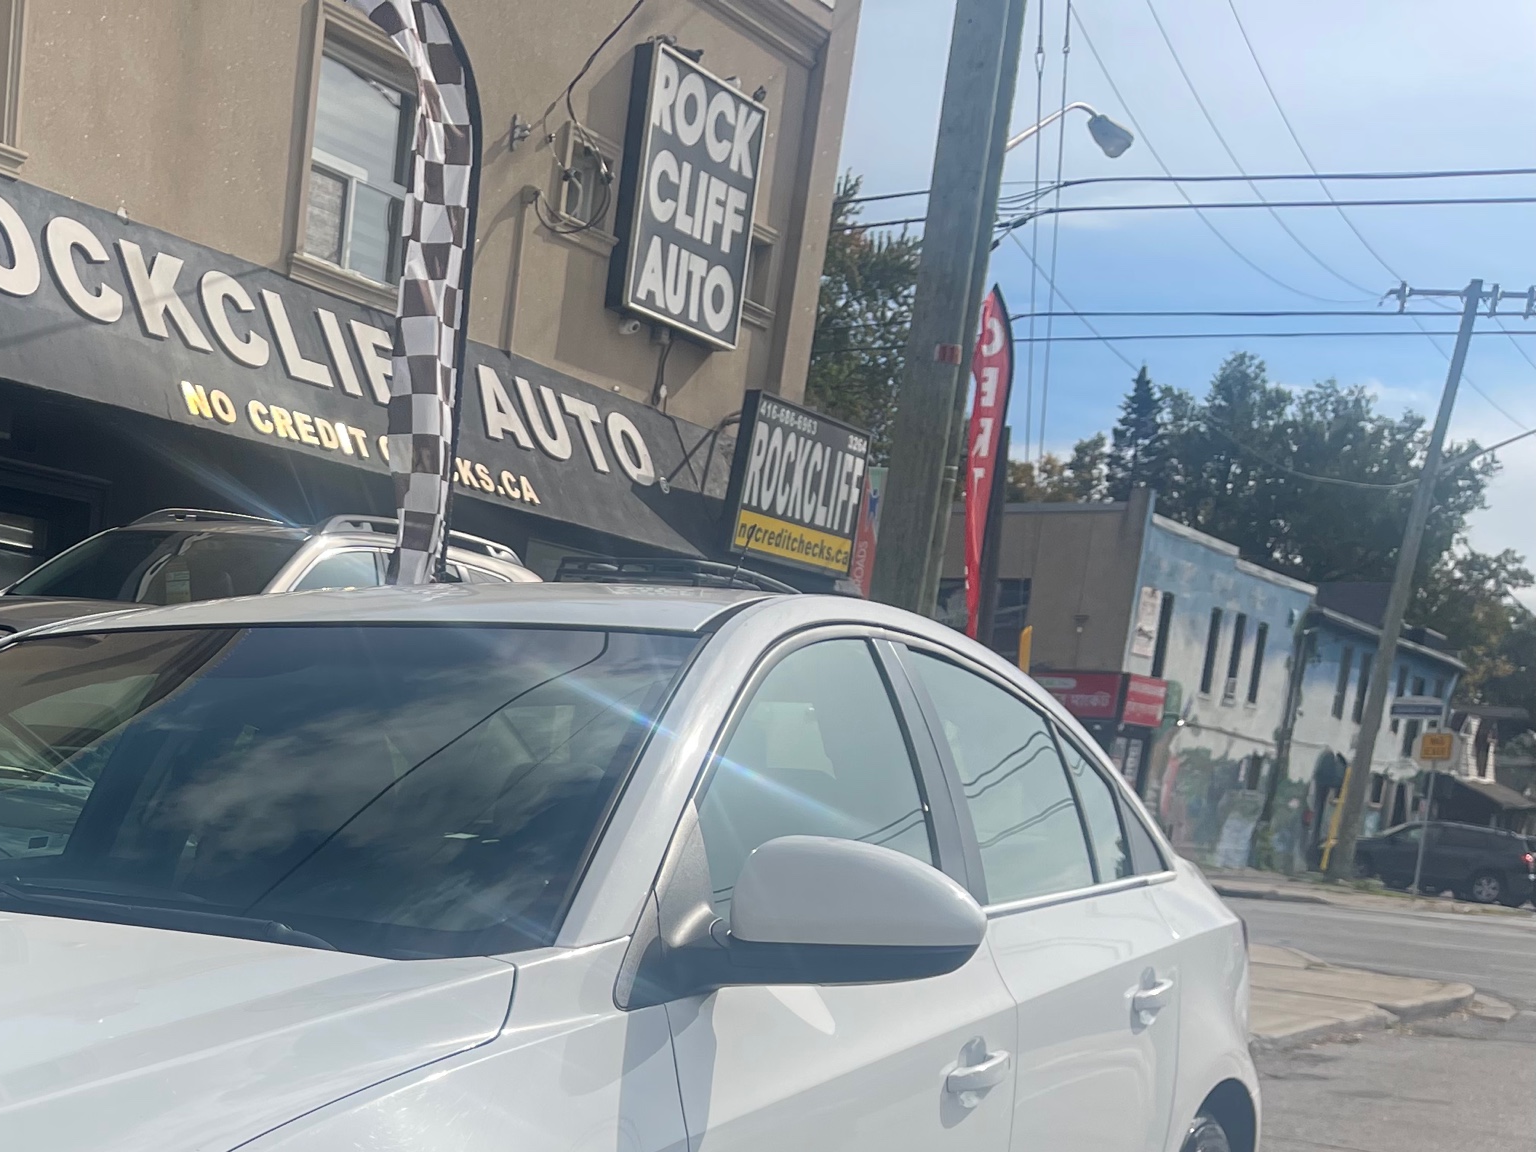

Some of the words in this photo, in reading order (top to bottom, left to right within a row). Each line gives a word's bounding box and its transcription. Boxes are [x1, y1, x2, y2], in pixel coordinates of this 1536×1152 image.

[653, 52, 762, 179] ROCK
[649, 149, 747, 253] CLIFF
[636, 235, 734, 333] AUTO
[180, 380, 237, 425] NO
[248, 399, 369, 458] CREDIT
[478, 364, 655, 487] AUTO
[848, 434, 868, 454] 3264
[743, 421, 864, 534] ROCKCLIFF
[737, 521, 849, 566] nocreditchecks.ca
